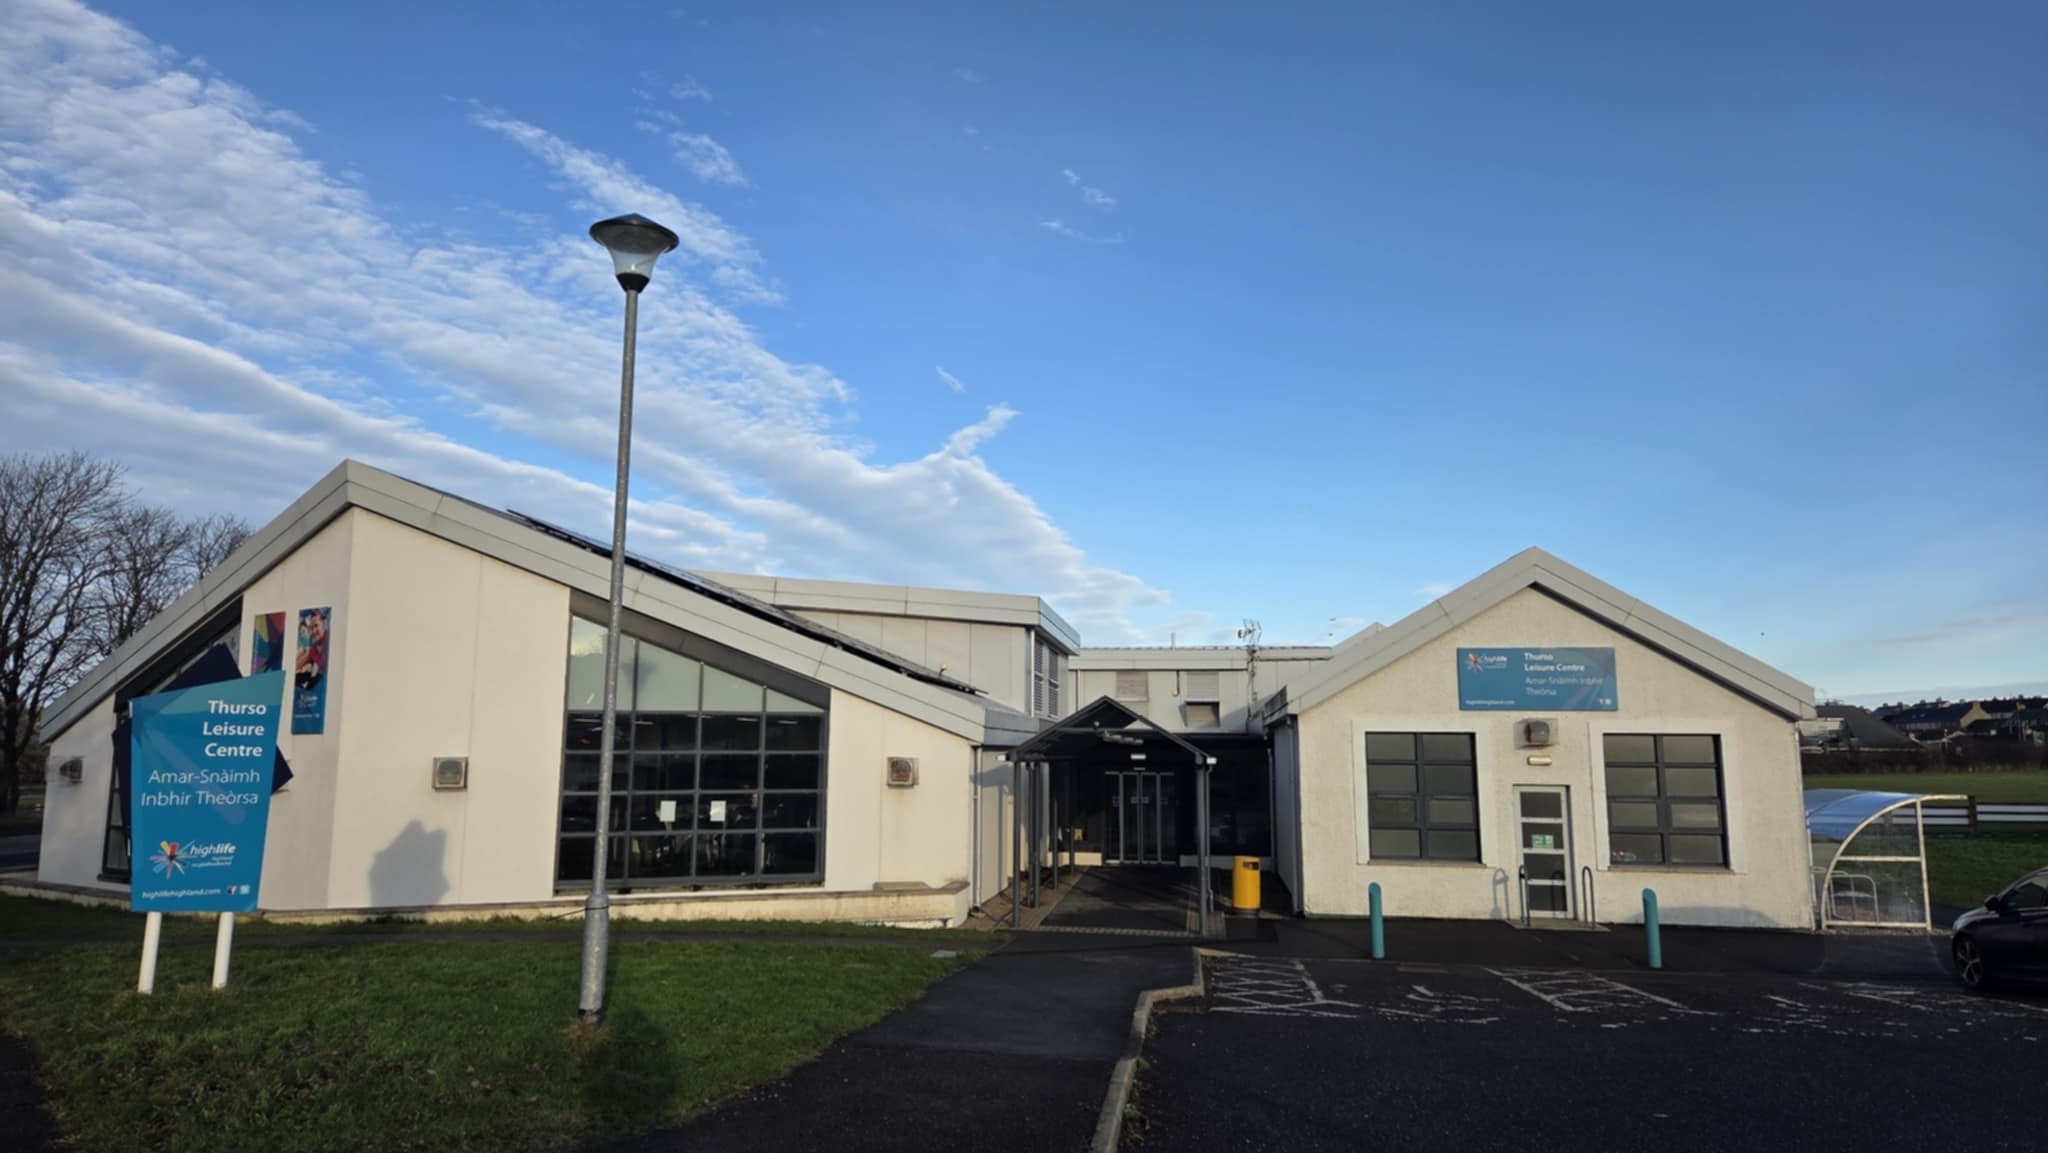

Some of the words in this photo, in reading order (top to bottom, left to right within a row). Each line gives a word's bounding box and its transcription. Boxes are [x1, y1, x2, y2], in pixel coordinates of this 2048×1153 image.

[1523, 652, 1554, 661] Thurso
[1524, 663, 1555, 672] Leisure
[1556, 663, 1585, 672] Centre
[207, 700, 267, 716] Thurso
[202, 721, 265, 736] Leisure
[204, 743, 263, 757] Centre
[147, 768, 261, 784] Amar-Snàimh
[141, 791, 192, 807] Inbhir
[195, 790, 258, 805] Theòrsa
[190, 842, 237, 858] highlife
